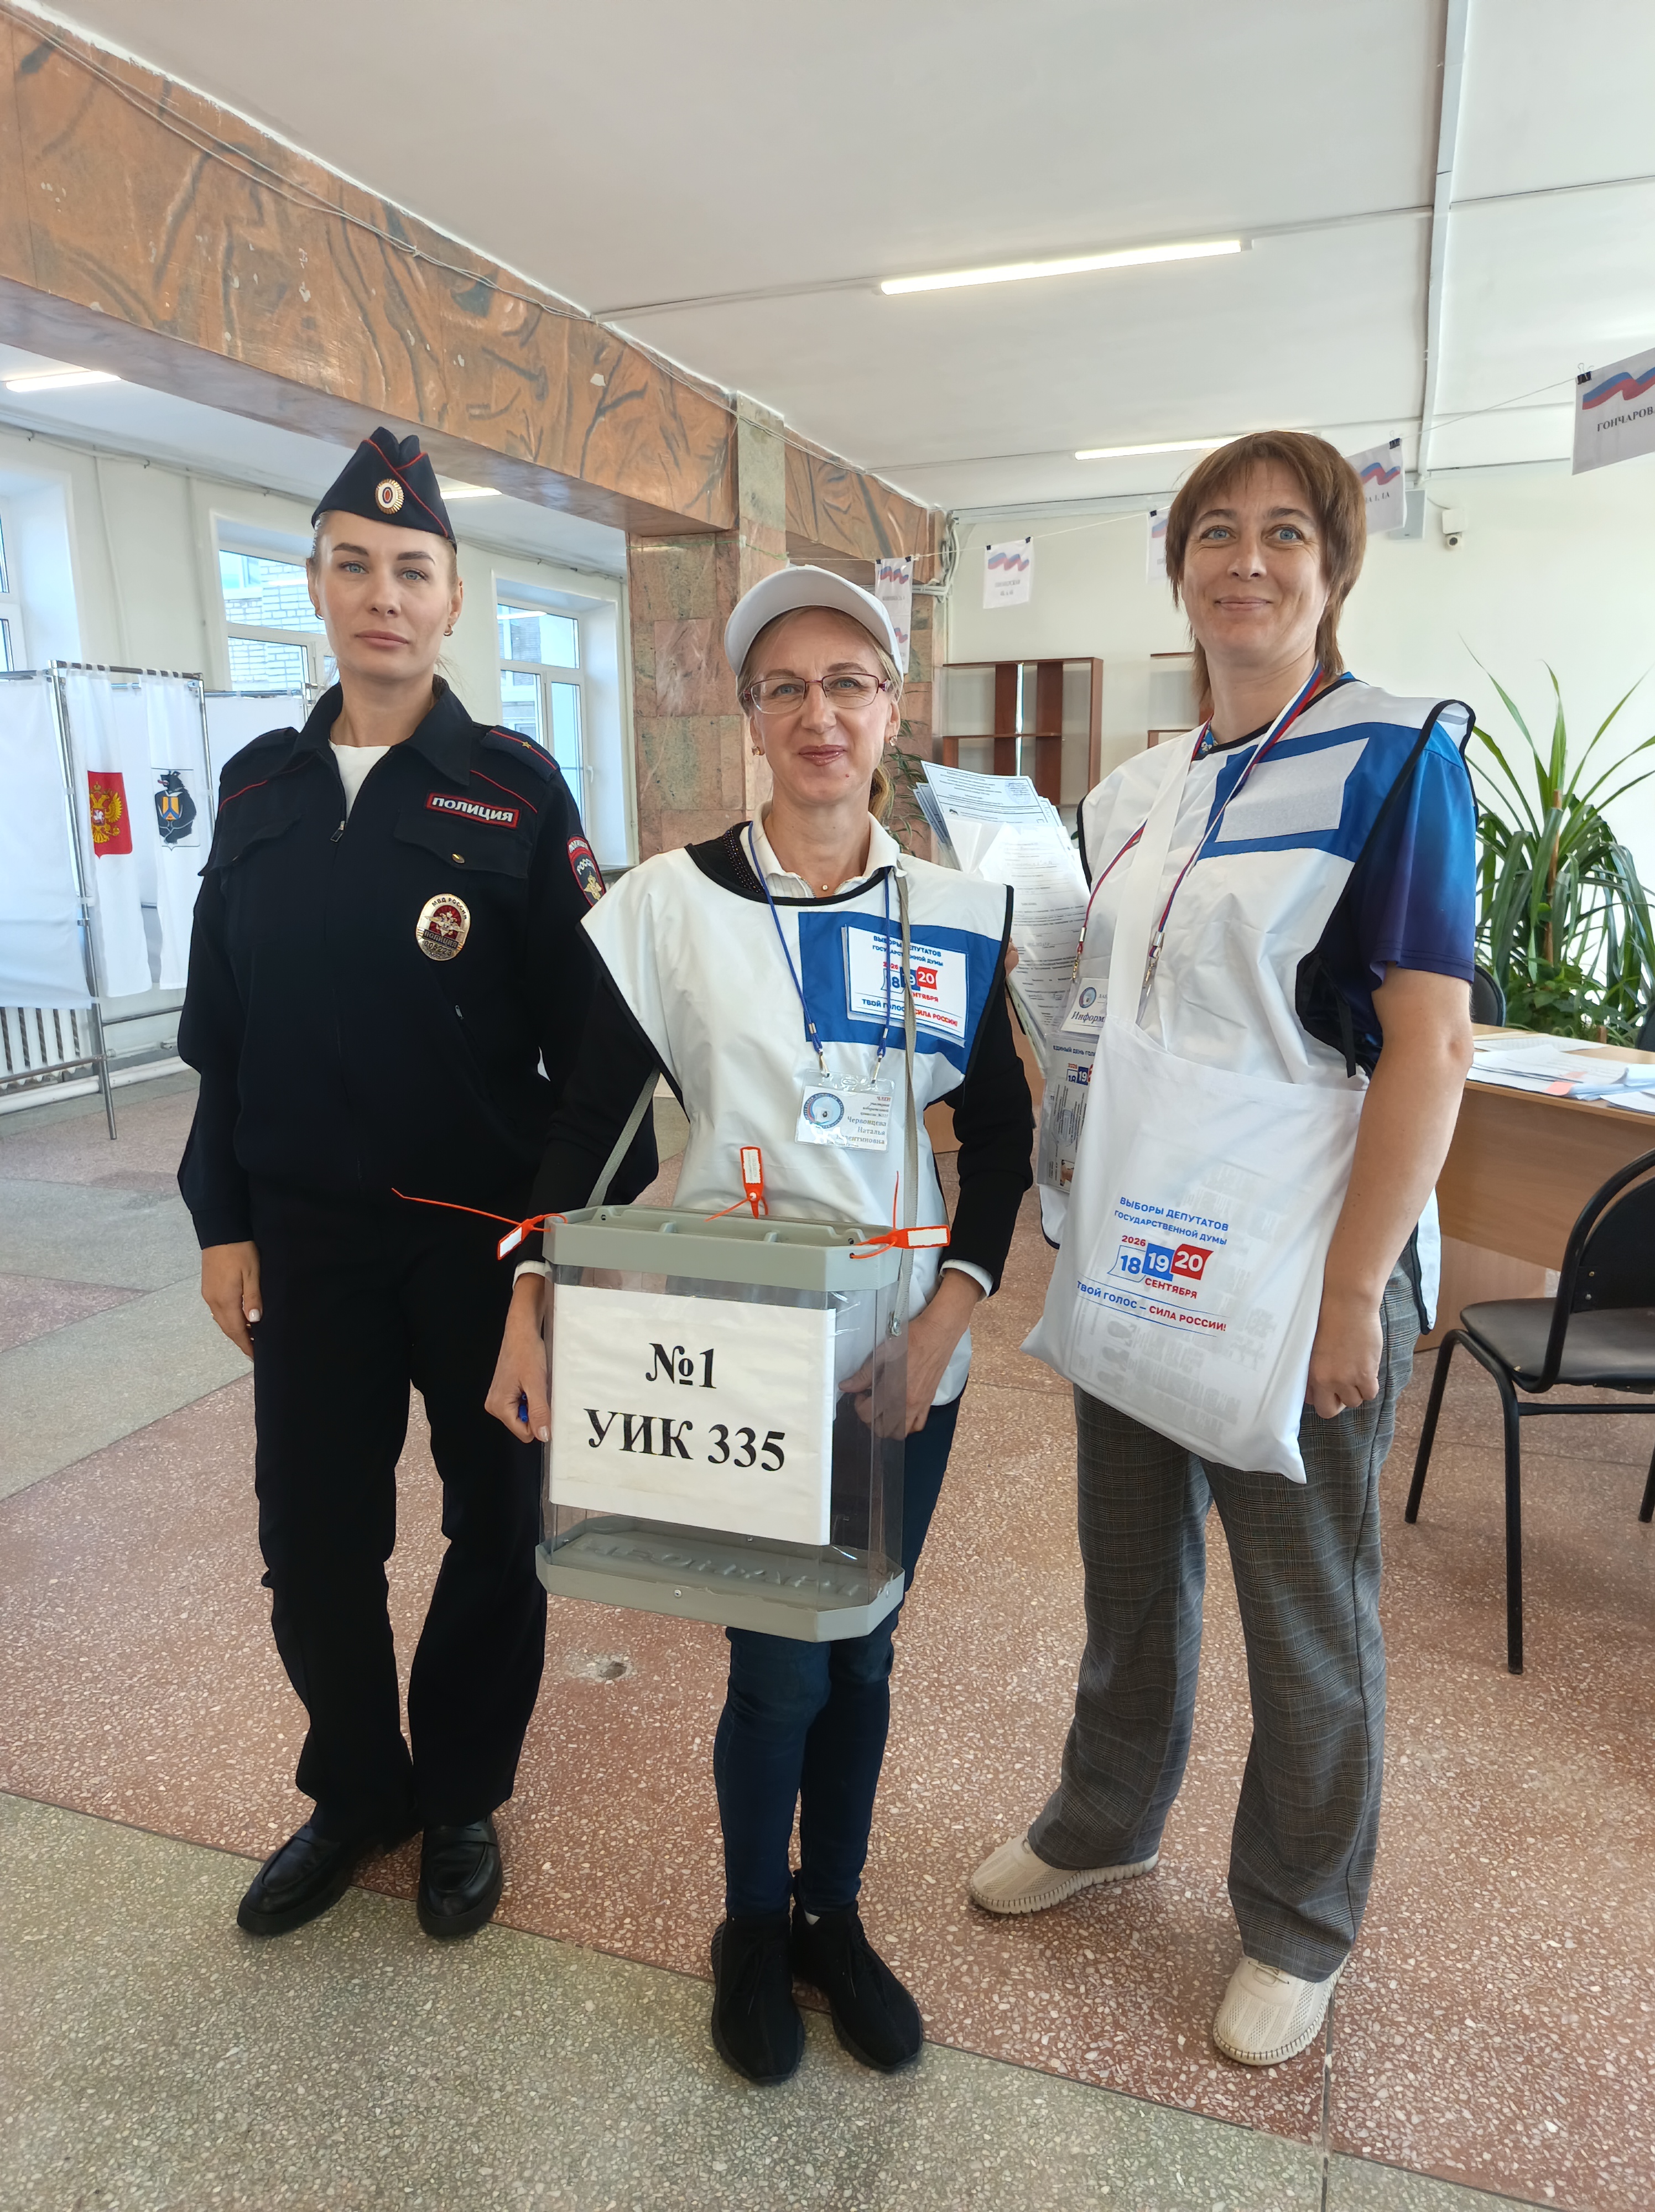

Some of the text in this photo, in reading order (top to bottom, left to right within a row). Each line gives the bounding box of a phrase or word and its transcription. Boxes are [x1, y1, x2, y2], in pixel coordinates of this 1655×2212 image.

[1597, 406, 1655, 431] ГОНЧАРОВ
[433, 797, 513, 822] ПОЛИЦИЯ
[909, 945, 941, 957] ЕПУТАТОВ
[883, 961, 898, 970] 226
[918, 971, 935, 985] 20
[861, 999, 881, 1008] ТВОЙ
[883, 1002, 905, 1012] ГЛОС
[1079, 1071, 1087, 1082] 19
[1120, 1197, 1164, 1215] ВЫБОРЫ
[1166, 1209, 1229, 1232] ДЕПУТАТОВ
[1114, 1210, 1227, 1245] ГОСУДАРСТВЕННОЙ ДУМЫ
[1121, 1235, 1146, 1247] 2026
[1121, 1251, 1204, 1275] 18 19 20
[1144, 1277, 1198, 1299] СЕНТЯБРЯ
[1077, 1280, 1101, 1298] ТВОЙ
[1104, 1292, 1137, 1309] ГОЛОС
[1149, 1306, 1177, 1321] СИЛА
[1179, 1314, 1227, 1332] РОССИИ!
[646, 1343, 717, 1389] №1
[583, 1408, 785, 1472] УИК 335
